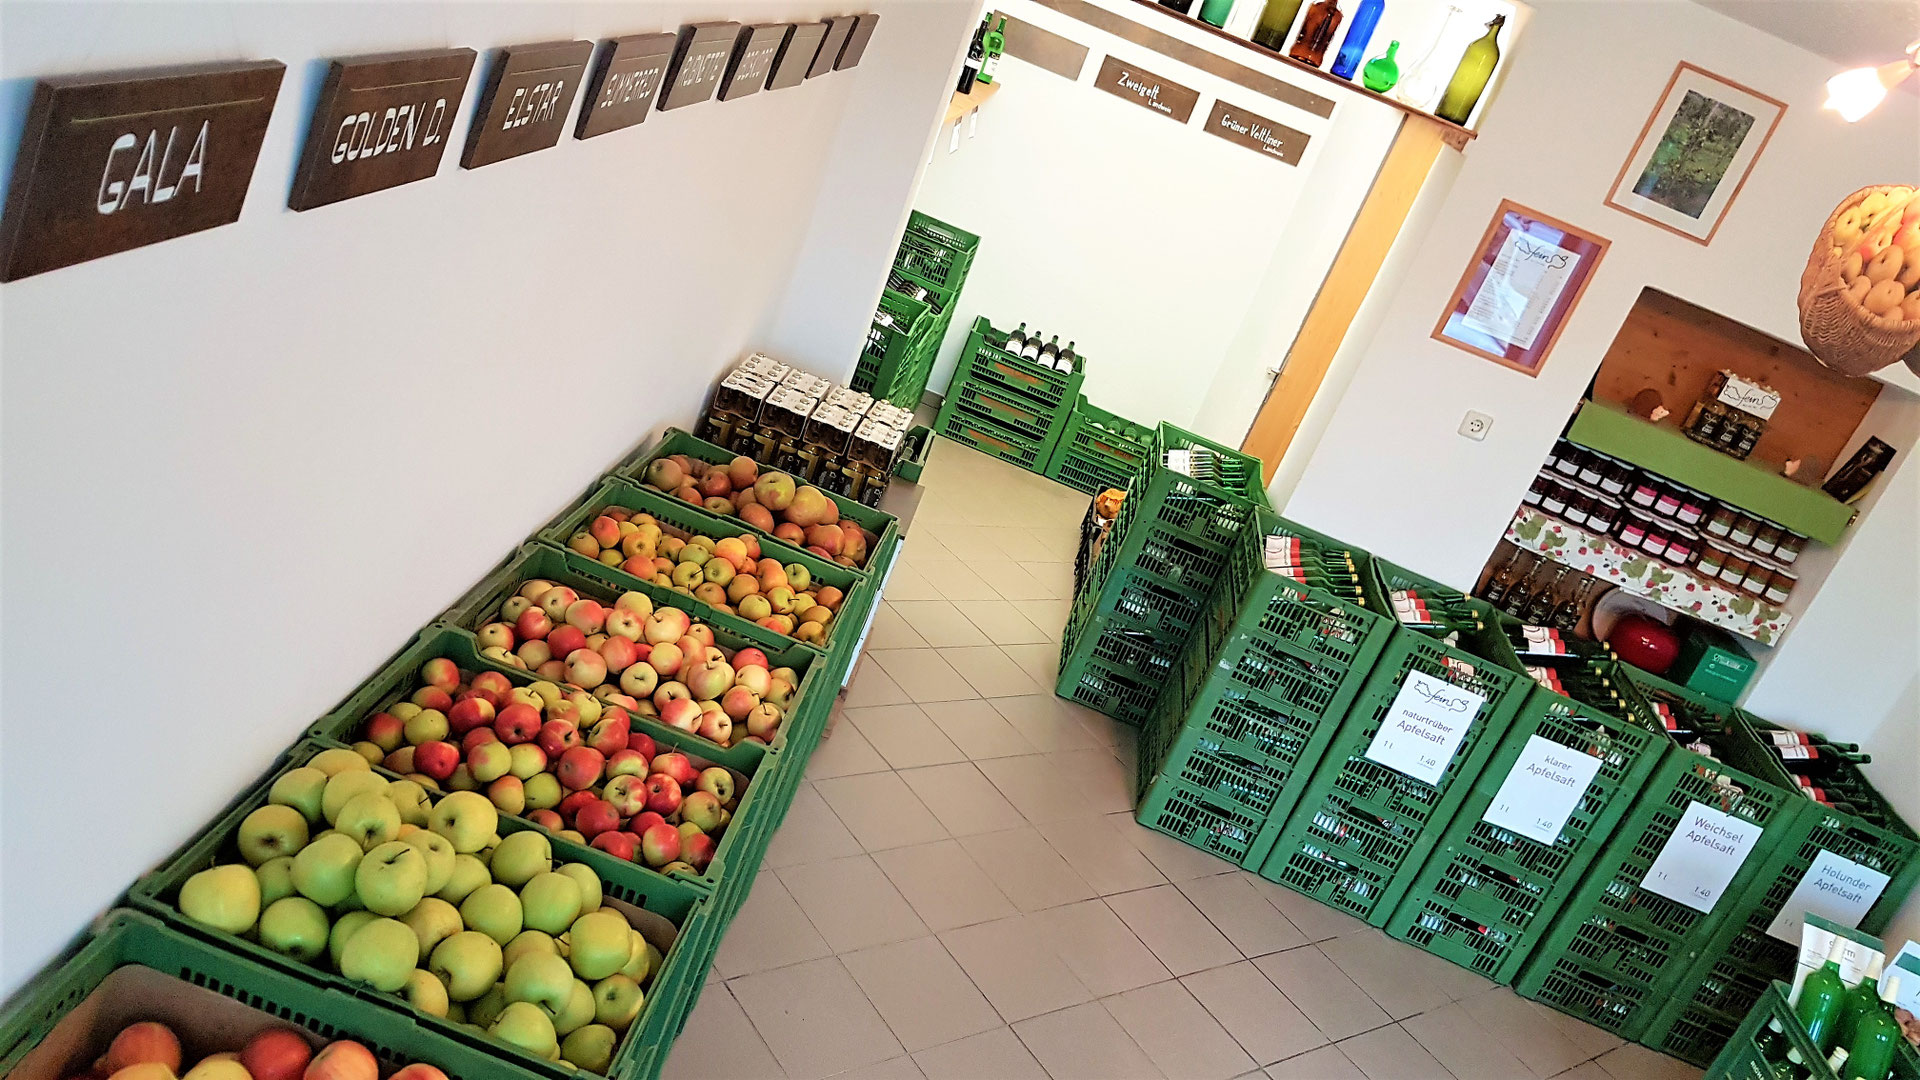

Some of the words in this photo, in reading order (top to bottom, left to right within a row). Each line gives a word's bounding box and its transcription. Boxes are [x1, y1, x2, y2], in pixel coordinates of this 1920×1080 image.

[1117, 71, 1160, 100] Zweigelt
[502, 80, 564, 130] ELSTAR
[331, 103, 426, 164] GOLDEN
[423, 99, 447, 144] D.
[1221, 113, 1249, 135] Grüner
[1250, 122, 1284, 148] Veltliner
[96, 119, 210, 215] GALA
[1396, 720, 1446, 746] Apfelsaft
[1402, 709, 1454, 734] naturtrüber
[1419, 755, 1436, 767] 1.40
[1544, 755, 1573, 772] klarer
[1526, 763, 1576, 788] Apfelsaft
[1536, 818, 1553, 830] 1.40
[1694, 816, 1744, 844] Weichsel
[1685, 830, 1736, 856] Apfelsaft
[1821, 864, 1872, 891] Holunder
[1694, 886, 1712, 898] 1.40
[1813, 878, 1862, 904] Apfelsaft
